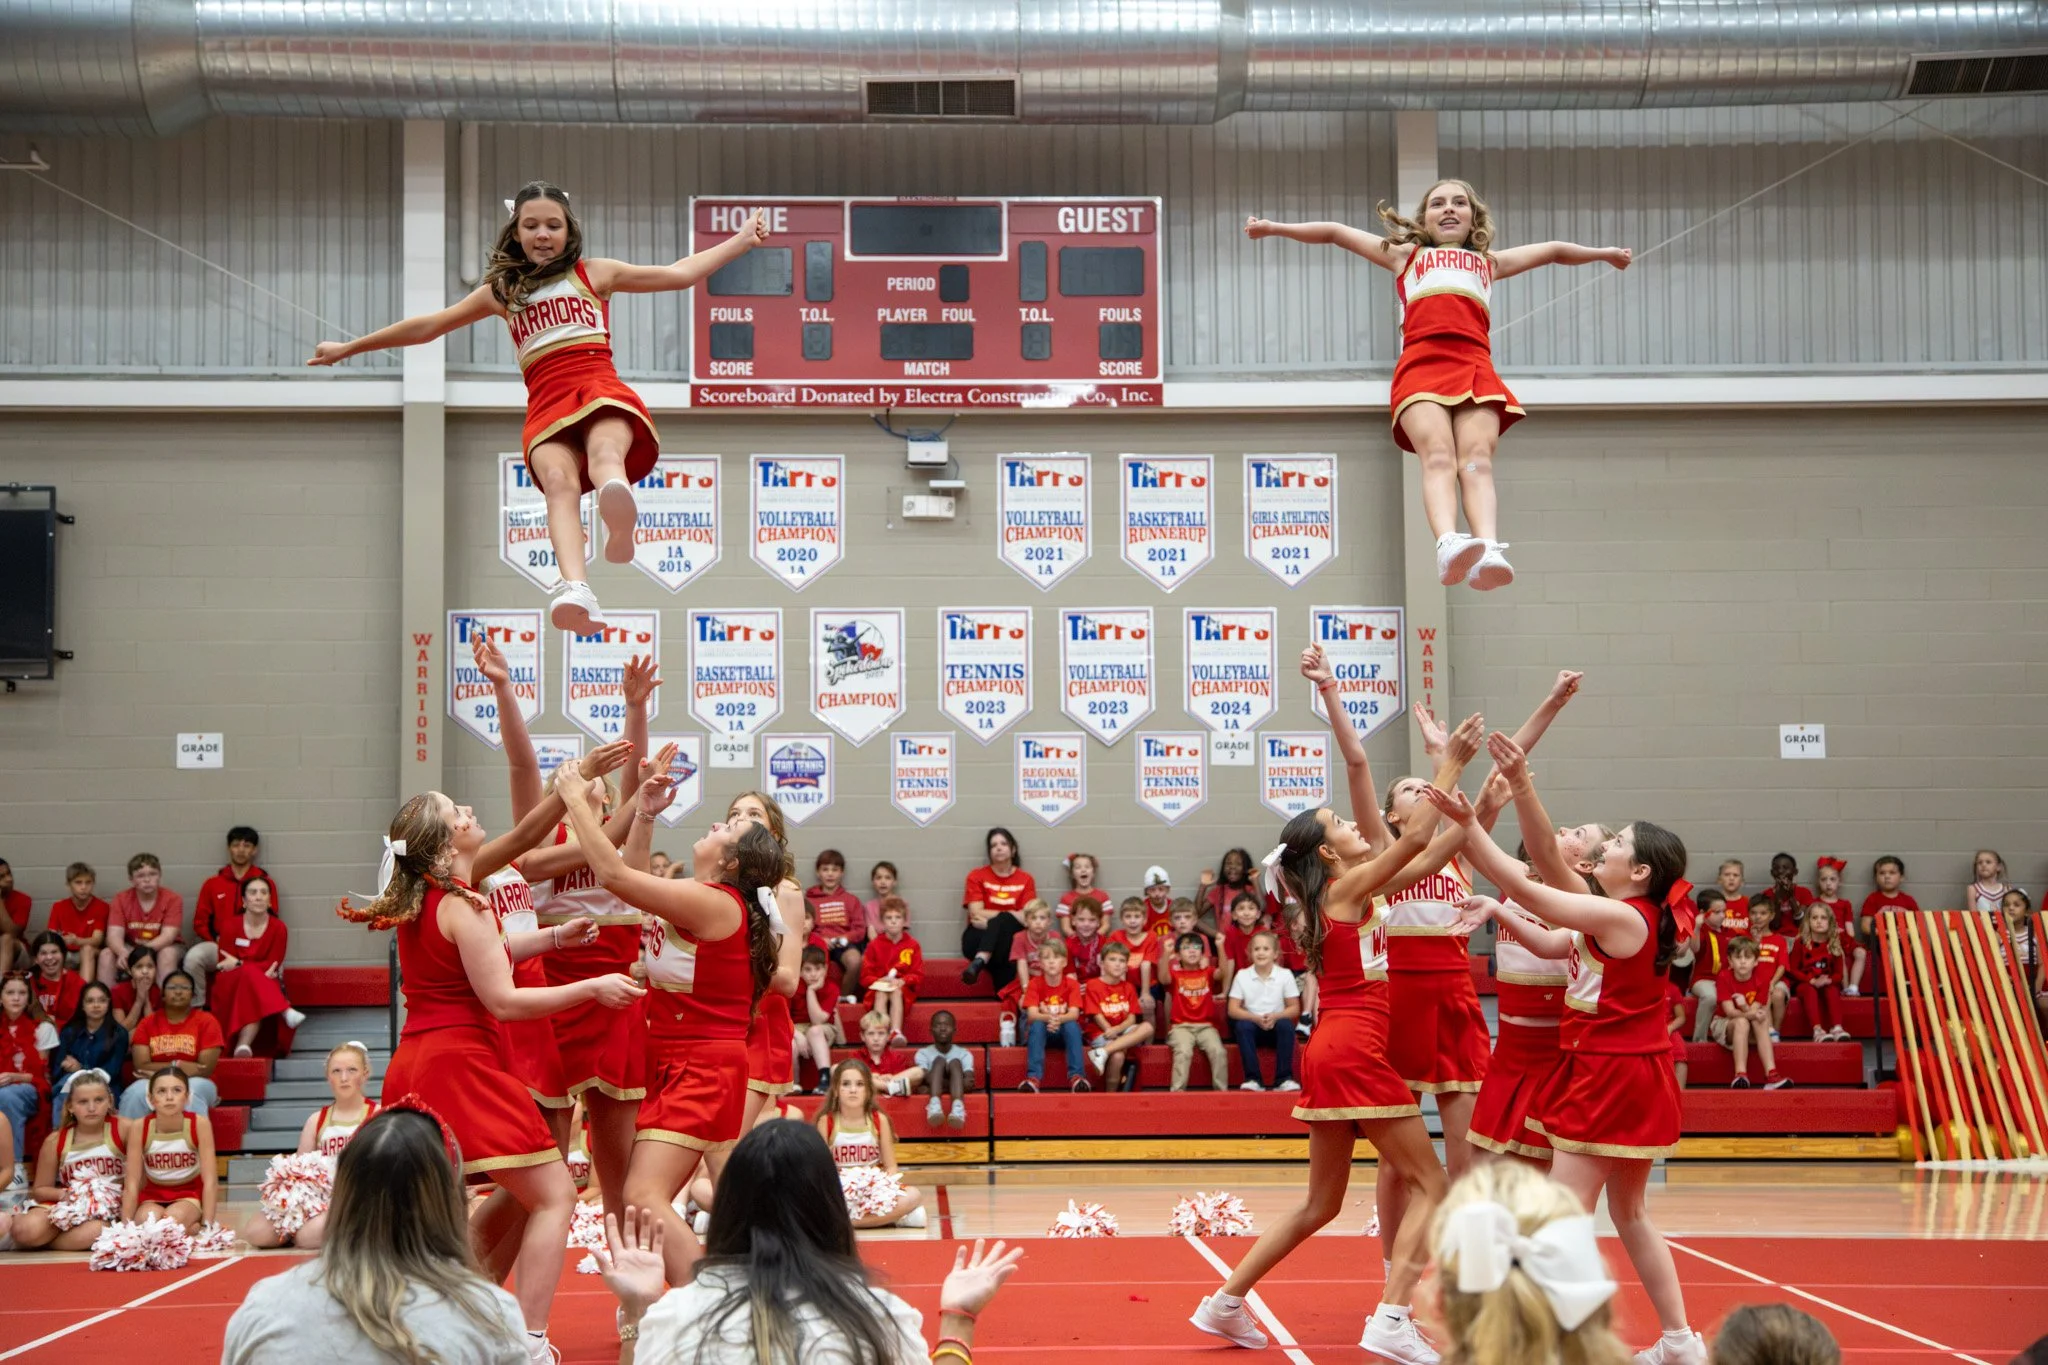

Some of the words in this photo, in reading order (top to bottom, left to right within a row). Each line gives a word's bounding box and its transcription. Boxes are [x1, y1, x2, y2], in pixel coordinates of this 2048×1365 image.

[1057, 207, 1145, 233] GUEST
[1414, 249, 1487, 289] WARRIORS
[887, 278, 936, 291] PERIOD
[711, 308, 753, 321] FOULS
[800, 308, 834, 321] T.O.L.
[878, 308, 927, 322] PLAYER
[942, 308, 976, 322] FOUL
[1020, 308, 1054, 322] T.O.L.
[1100, 308, 1142, 321] FOULS
[510, 296, 596, 349] WARRIORS
[710, 362, 753, 376] SCORE
[904, 362, 950, 376] MATCH
[1099, 362, 1142, 376] SCORE
[700, 388, 796, 404] Scoreboard
[801, 388, 874, 404] Donated
[880, 388, 899, 406] by
[905, 388, 962, 404] Electra
[1121, 388, 1154, 403] Inc.
[637, 512, 713, 527] VOLLEYBALL
[758, 511, 836, 527] VOLLEYBALL
[1006, 511, 1083, 527] VOLLEYBALL
[1129, 512, 1206, 527] BASKETBALL
[1253, 511, 1278, 524] GIRLS
[1281, 511, 1329, 523] ATHLETICS
[635, 528, 714, 544] CHAMPION
[758, 527, 836, 544] CHAMPION
[1005, 526, 1083, 543] CHAMPION
[1129, 526, 1207, 543] RUNNERUP
[1252, 525, 1329, 539] CHAMPION
[528, 550, 557, 566] 201
[668, 546, 684, 558] 1A
[777, 548, 818, 561] 2020
[1025, 548, 1064, 561] 2021
[1147, 548, 1186, 561] 2021
[1272, 547, 1310, 559] 2021
[658, 560, 691, 572] 2018
[1038, 564, 1053, 575] 1A
[1160, 565, 1176, 576] 1A
[1284, 566, 1300, 574] 1A
[696, 665, 775, 681] BASKETBALL
[947, 664, 1024, 679] TENNIS
[1069, 664, 1147, 680] VOLLEYBALL
[1192, 664, 1270, 680] VOLLEYBALL
[1336, 664, 1381, 679] GOLF
[1417, 628, 1436, 720] WARRIO
[695, 681, 775, 698] CHAMPIONS
[946, 681, 1024, 697] CHAMPION
[1069, 681, 1147, 697] CHAMPION
[1191, 681, 1270, 697] CHAMPION
[413, 633, 432, 762] WARRIORS
[819, 693, 897, 709] CHAMPION
[716, 703, 756, 716] 2022
[965, 701, 1006, 714] 2023
[1088, 702, 1128, 715] 2023
[1210, 702, 1251, 715] 2024
[603, 722, 618, 732] 1A
[728, 721, 745, 731] 1A
[978, 718, 994, 729] 1A
[1101, 719, 1117, 729] 1A
[1224, 719, 1239, 729] 1A
[1785, 734, 1821, 743] GRADE
[182, 744, 218, 752] GRADE
[714, 744, 750, 753] GRADE
[1215, 742, 1249, 750] GRADE
[196, 754, 204, 762] 4
[729, 753, 735, 761] 3
[772, 760, 794, 772] TEAM
[796, 760, 824, 772] TENNIS
[897, 768, 948, 777] DISTRICT
[1023, 768, 1078, 777] REGIONAL
[1144, 766, 1199, 775] DISTRICT
[1269, 767, 1323, 776] DISTRICT
[897, 778, 948, 788] TENNIS
[1023, 779, 1046, 788] TRACK
[1057, 779, 1078, 788] FIELD
[1144, 777, 1199, 787] TENNIS
[1269, 778, 1324, 787] TENNIS
[897, 789, 948, 800] CHAMPION
[1023, 790, 1049, 800] THIRD
[1052, 791, 1078, 800] PLACE
[1144, 788, 1199, 798] CHAMPION
[1269, 788, 1324, 799] RUNNER-UP
[1387, 874, 1464, 906] ARRIORS
[833, 1145, 879, 1162] ARRIORS
